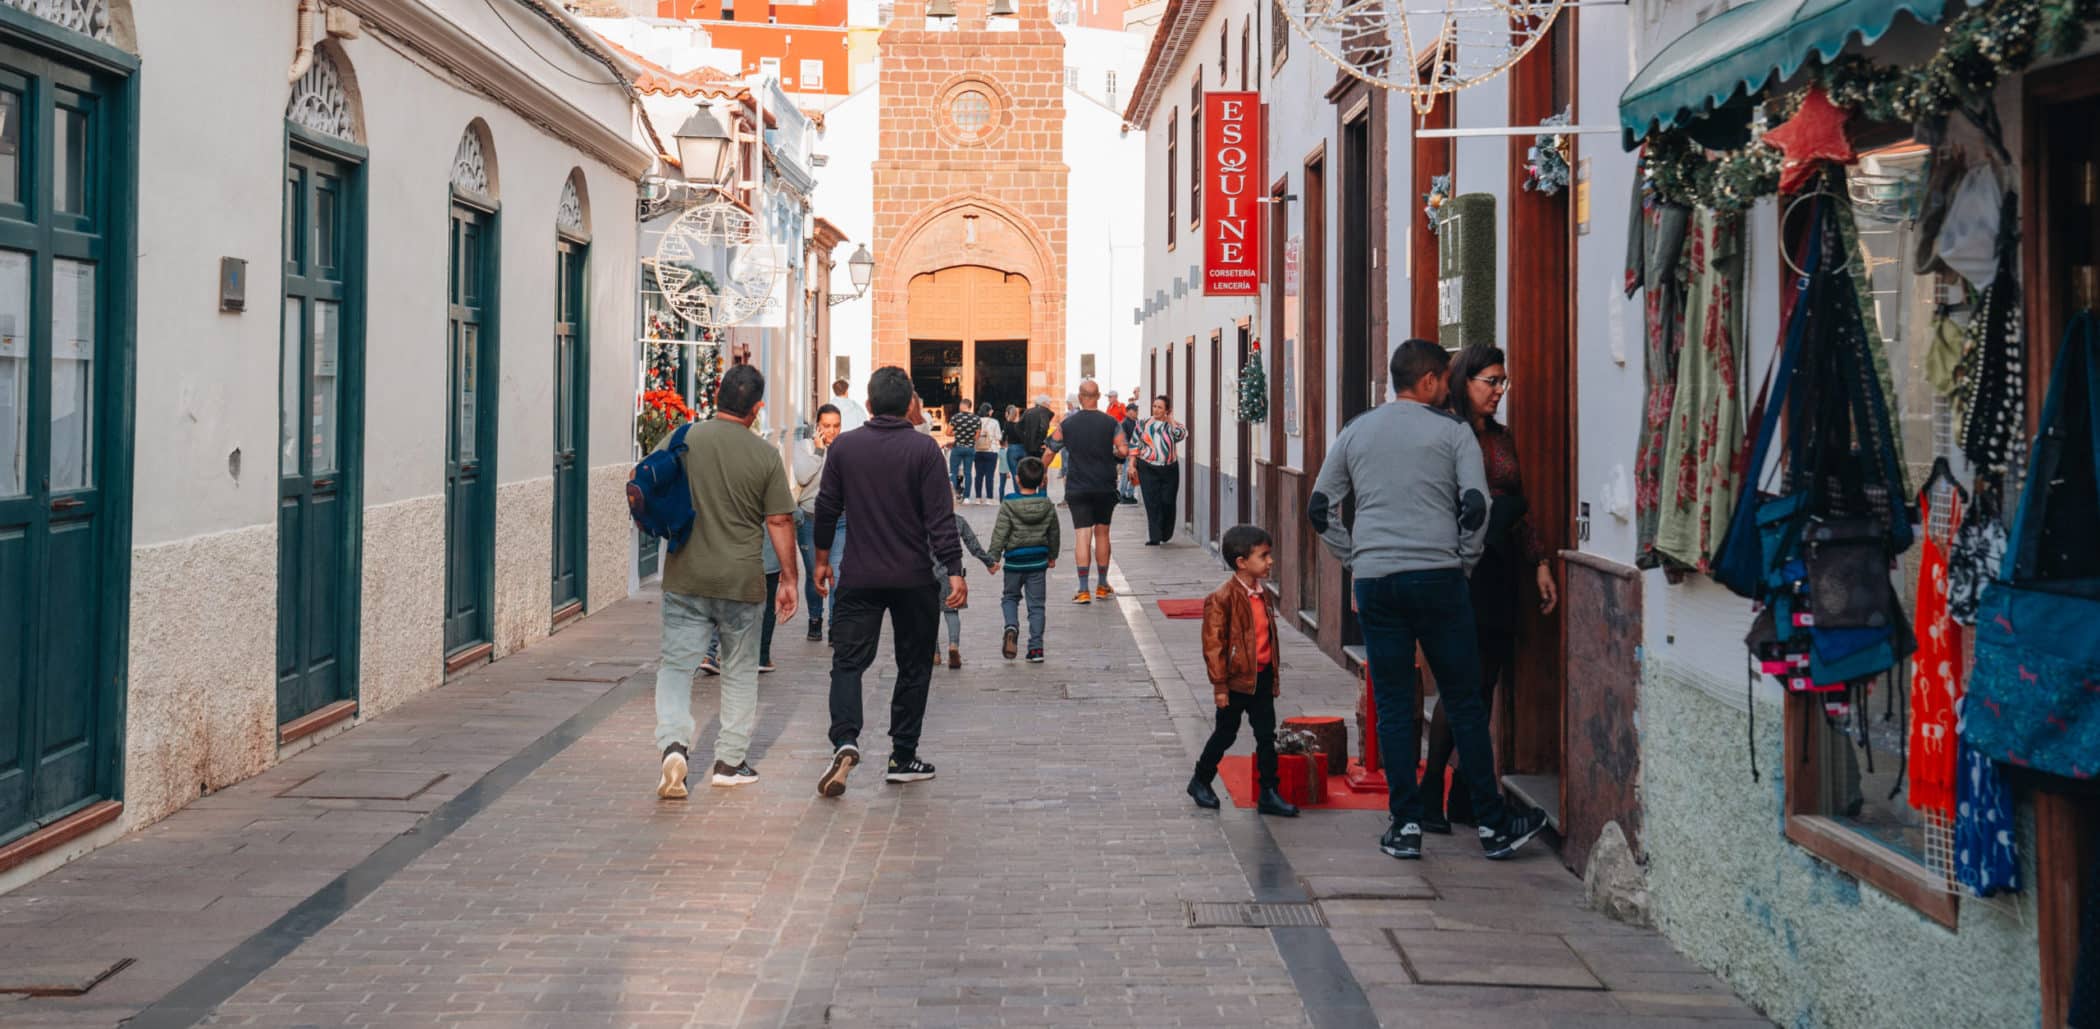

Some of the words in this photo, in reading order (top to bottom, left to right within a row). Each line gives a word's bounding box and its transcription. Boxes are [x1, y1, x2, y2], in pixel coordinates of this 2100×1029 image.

[1217, 100, 1247, 263] ESQUINE
[1209, 268, 1256, 277] CORSETERÍA
[1213, 281, 1251, 289] LENCERÍA
